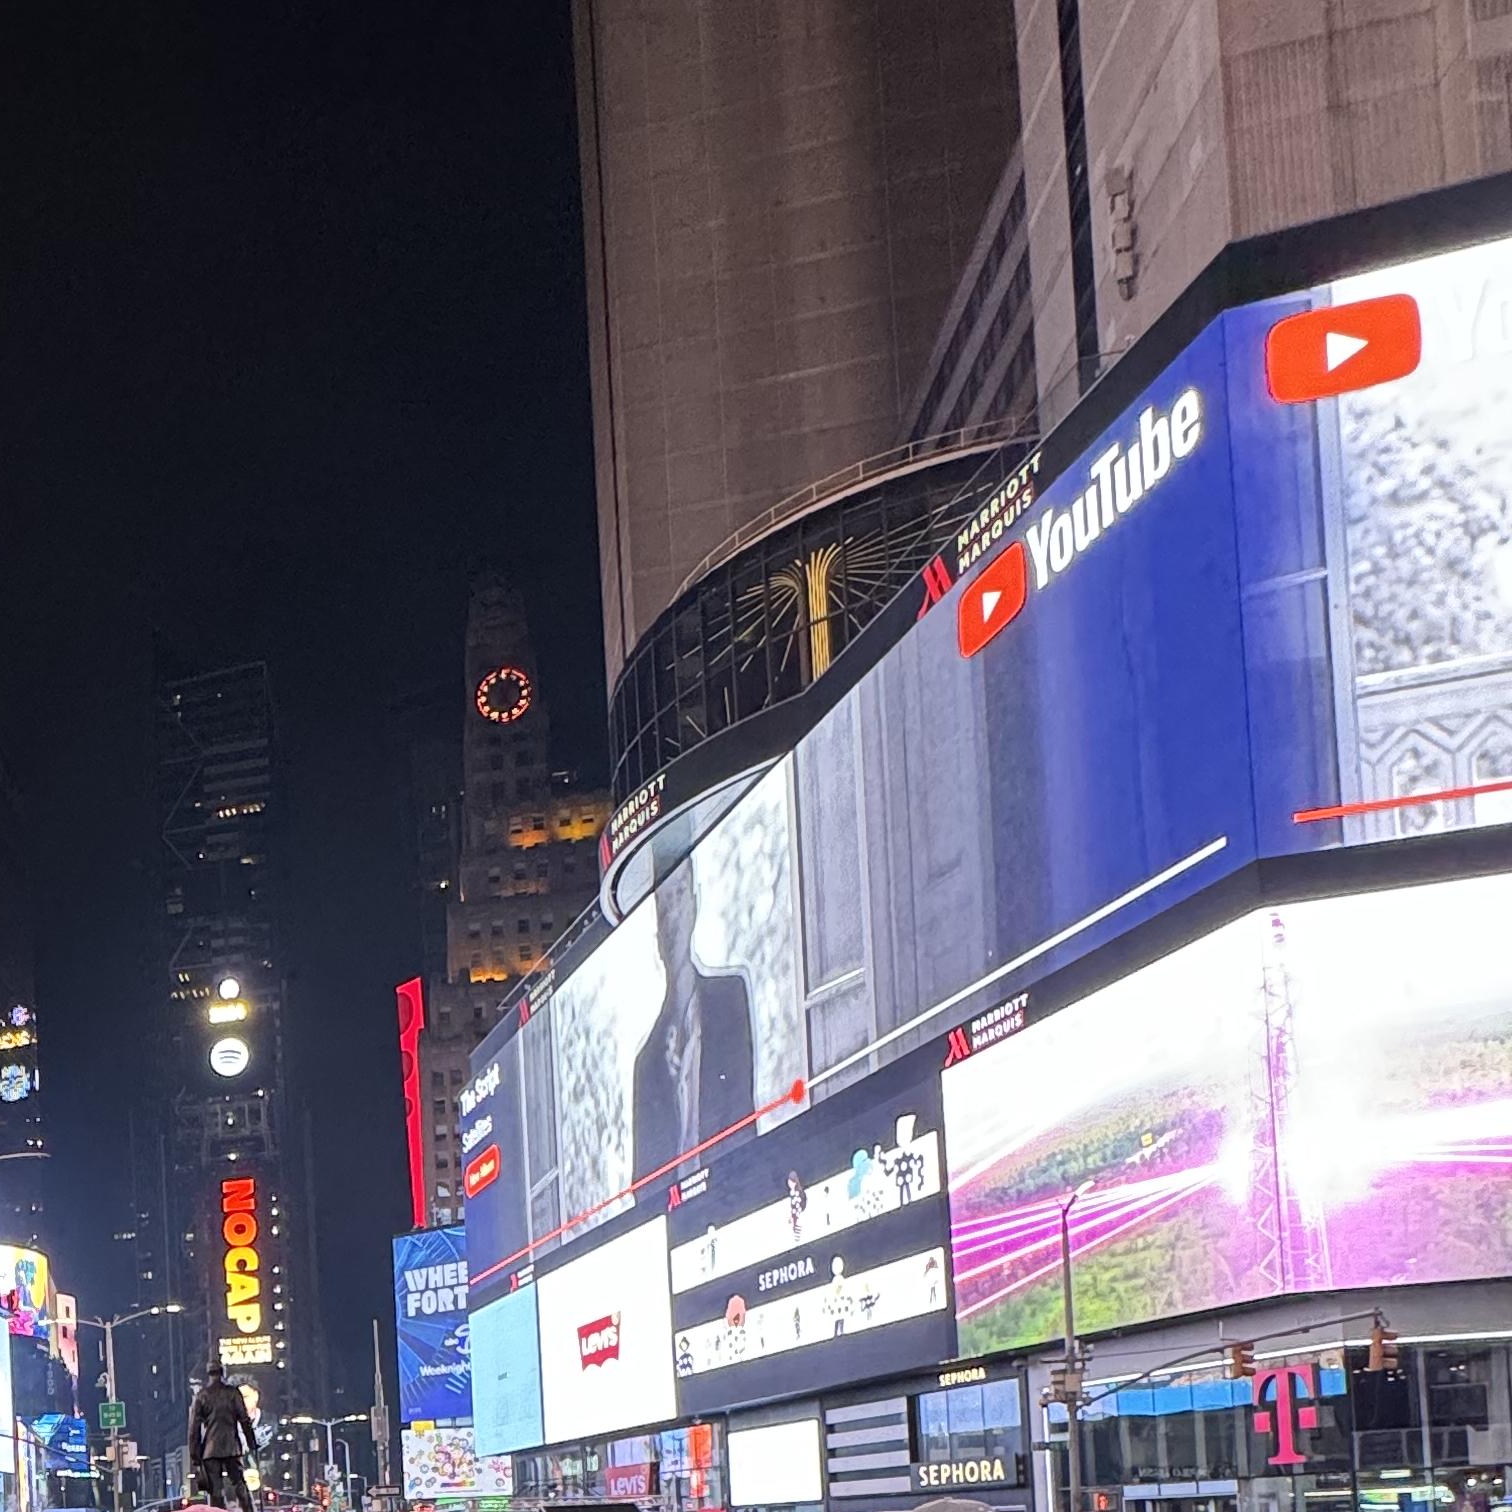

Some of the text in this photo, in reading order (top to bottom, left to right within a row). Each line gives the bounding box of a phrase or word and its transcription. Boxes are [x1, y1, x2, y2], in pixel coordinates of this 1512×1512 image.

[956, 451, 1042, 554] MARRIOTT
[1025, 387, 1201, 592] YouTube
[957, 482, 1035, 576] MARQUIS
[610, 773, 667, 836] MARRIOTT
[611, 799, 659, 855] MARQUIS
[970, 993, 1029, 1031] MARRIOTT
[971, 1012, 1024, 1049] MARQUIS
[758, 1257, 815, 1292] SEPHORA
[939, 1366, 987, 1387] SEPHORA
[918, 1457, 1005, 1487] SEPHORA
